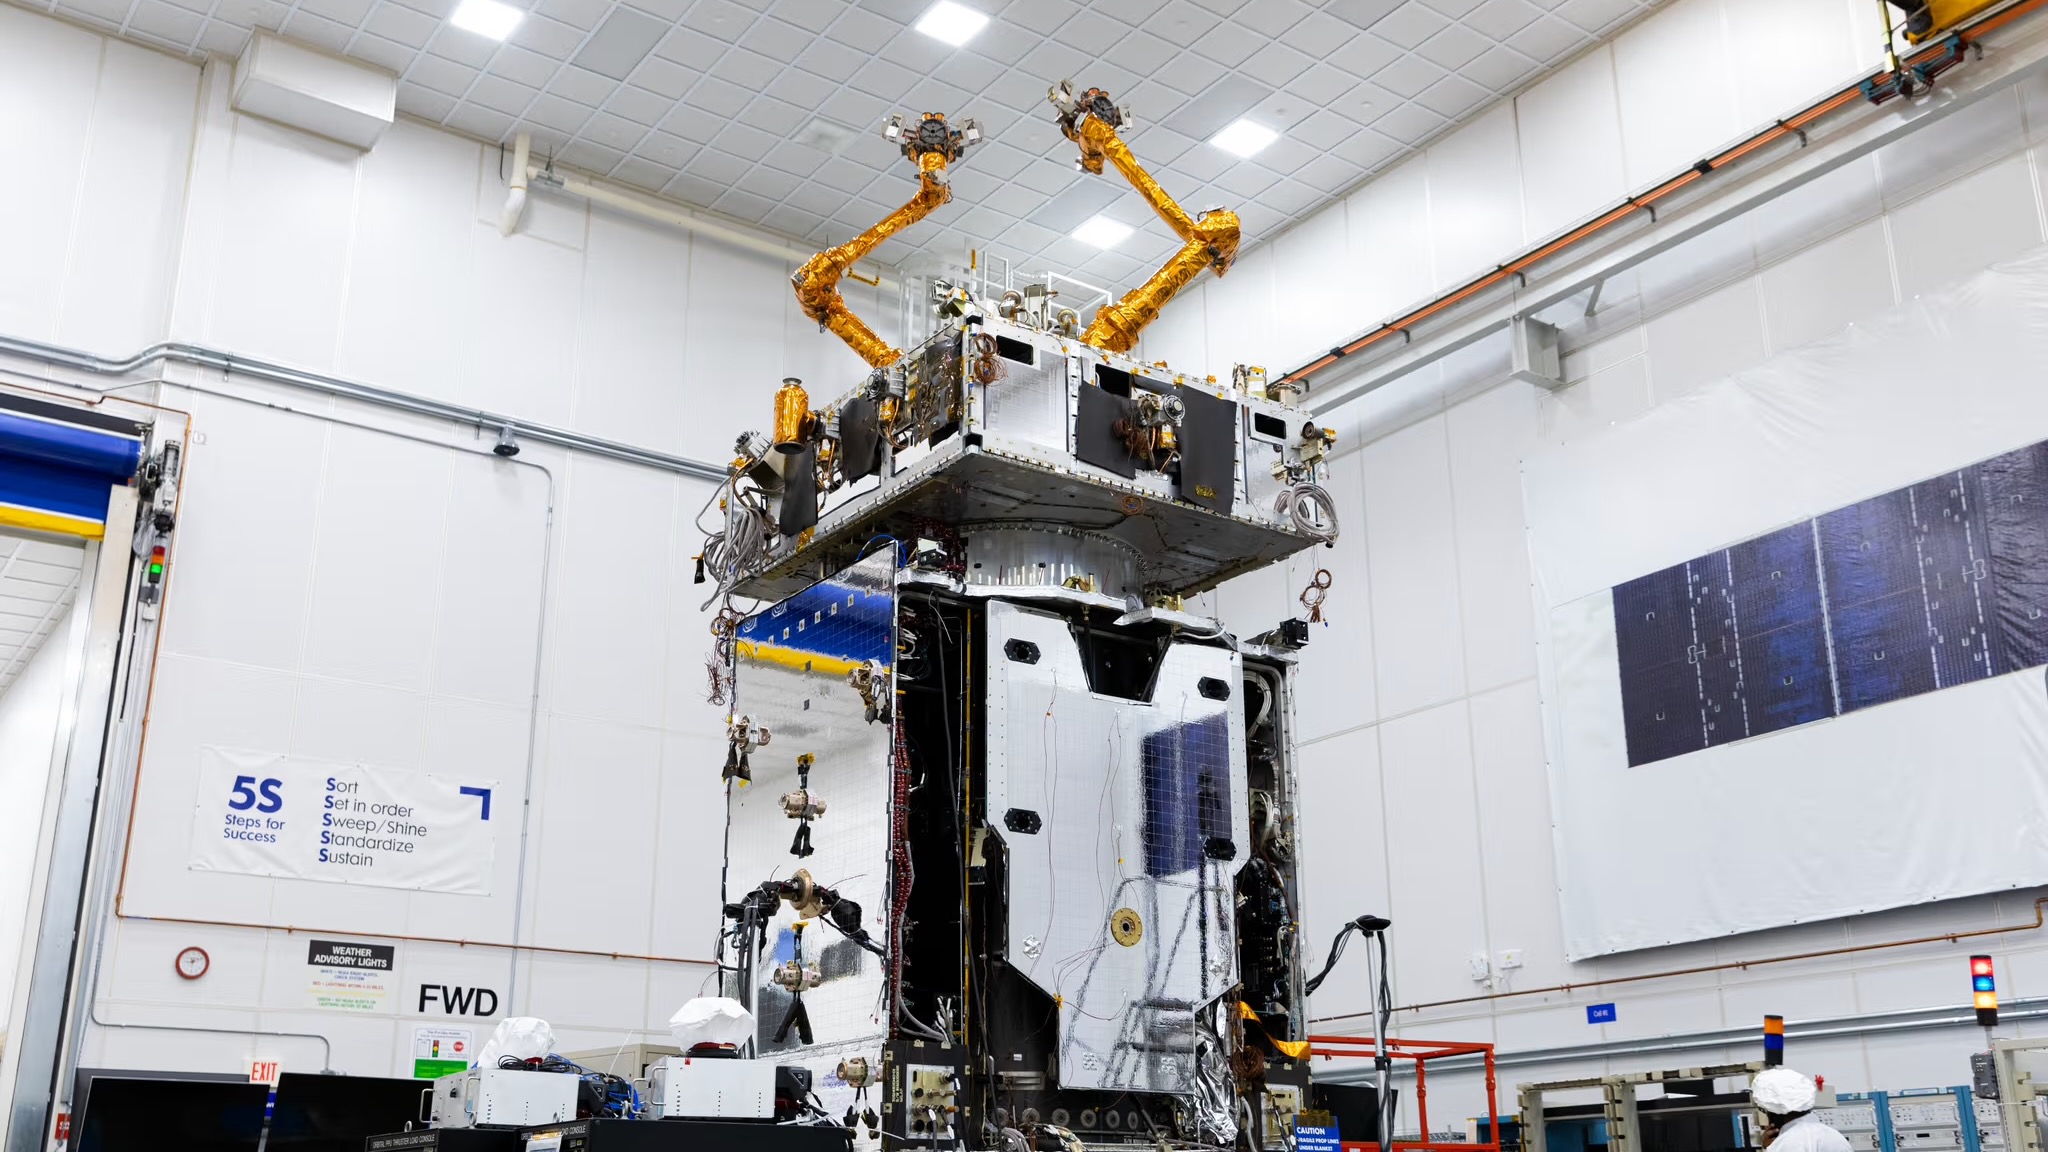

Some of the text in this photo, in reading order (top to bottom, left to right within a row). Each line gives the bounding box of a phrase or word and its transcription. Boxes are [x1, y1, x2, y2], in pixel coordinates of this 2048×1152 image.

[326, 777, 358, 793] Sort
[228, 775, 283, 813] 5S
[324, 795, 413, 817] Set in order
[225, 813, 285, 829] Steps for
[322, 813, 427, 837] Sweep/Shine
[224, 827, 276, 843] Success
[320, 830, 414, 853] Standardize
[318, 848, 373, 867] Sustain
[332, 946, 372, 957] WEATHER
[314, 954, 387, 968] ADVISORY LIGHTS
[419, 984, 498, 1016] FWD
[251, 1062, 278, 1081] EXIT
[569, 1125, 586, 1134] CONSOLE
[1296, 1127, 1325, 1135] CAUTION
[372, 1141, 385, 1149] ORBITAL
[393, 1138, 410, 1146] THRUSTER
[419, 1134, 435, 1143] CONSOLE
